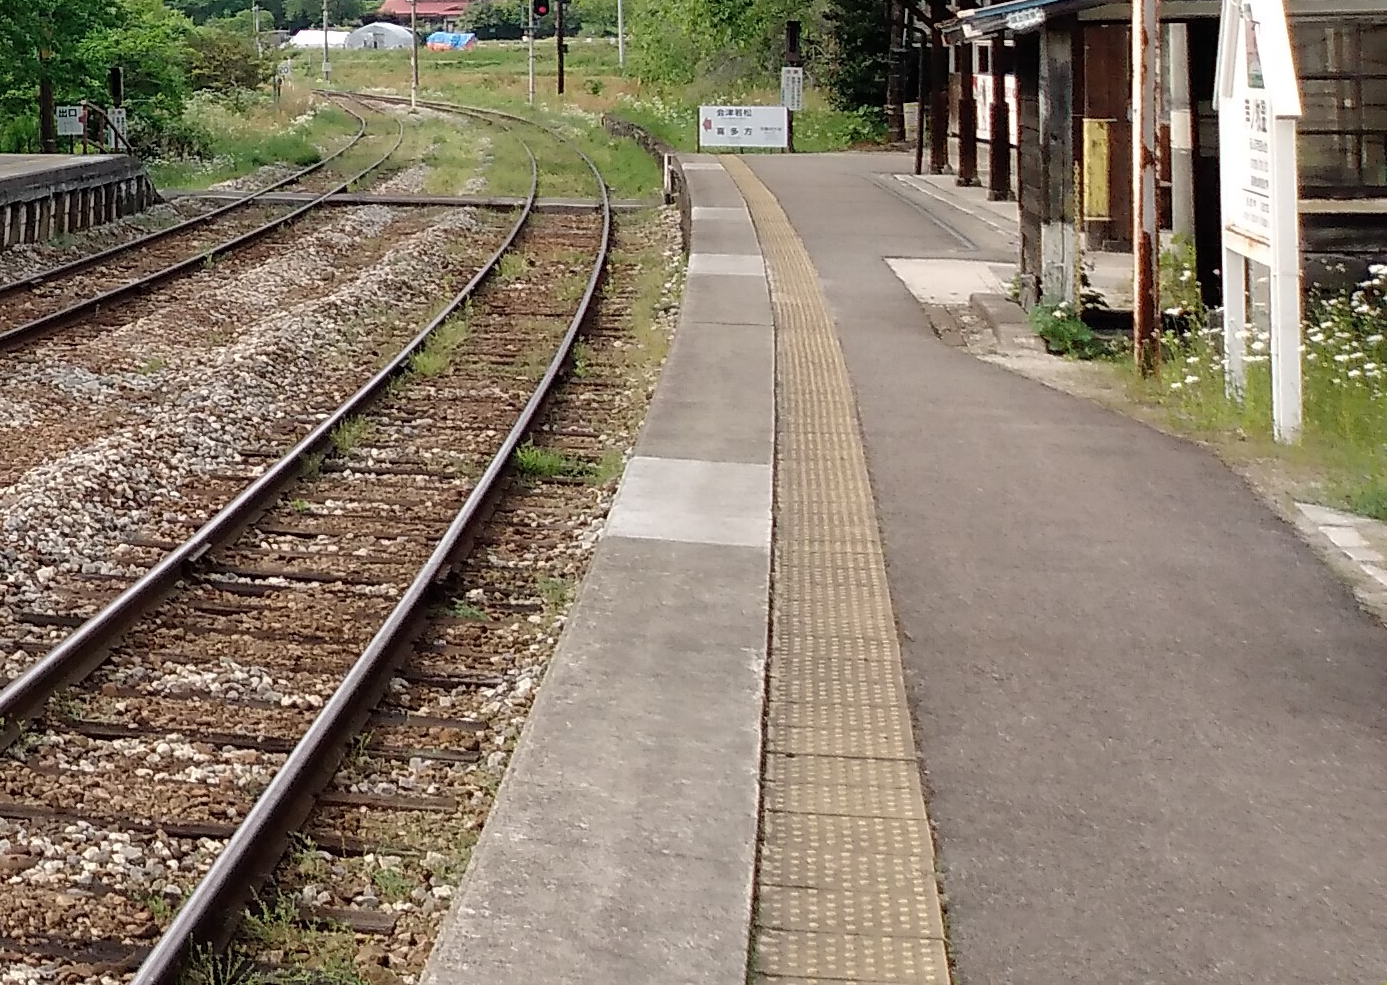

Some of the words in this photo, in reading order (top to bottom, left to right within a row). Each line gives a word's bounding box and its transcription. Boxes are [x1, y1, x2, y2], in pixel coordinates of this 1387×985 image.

[59, 109, 77, 117] 出口
[717, 109, 752, 117] 会津若松
